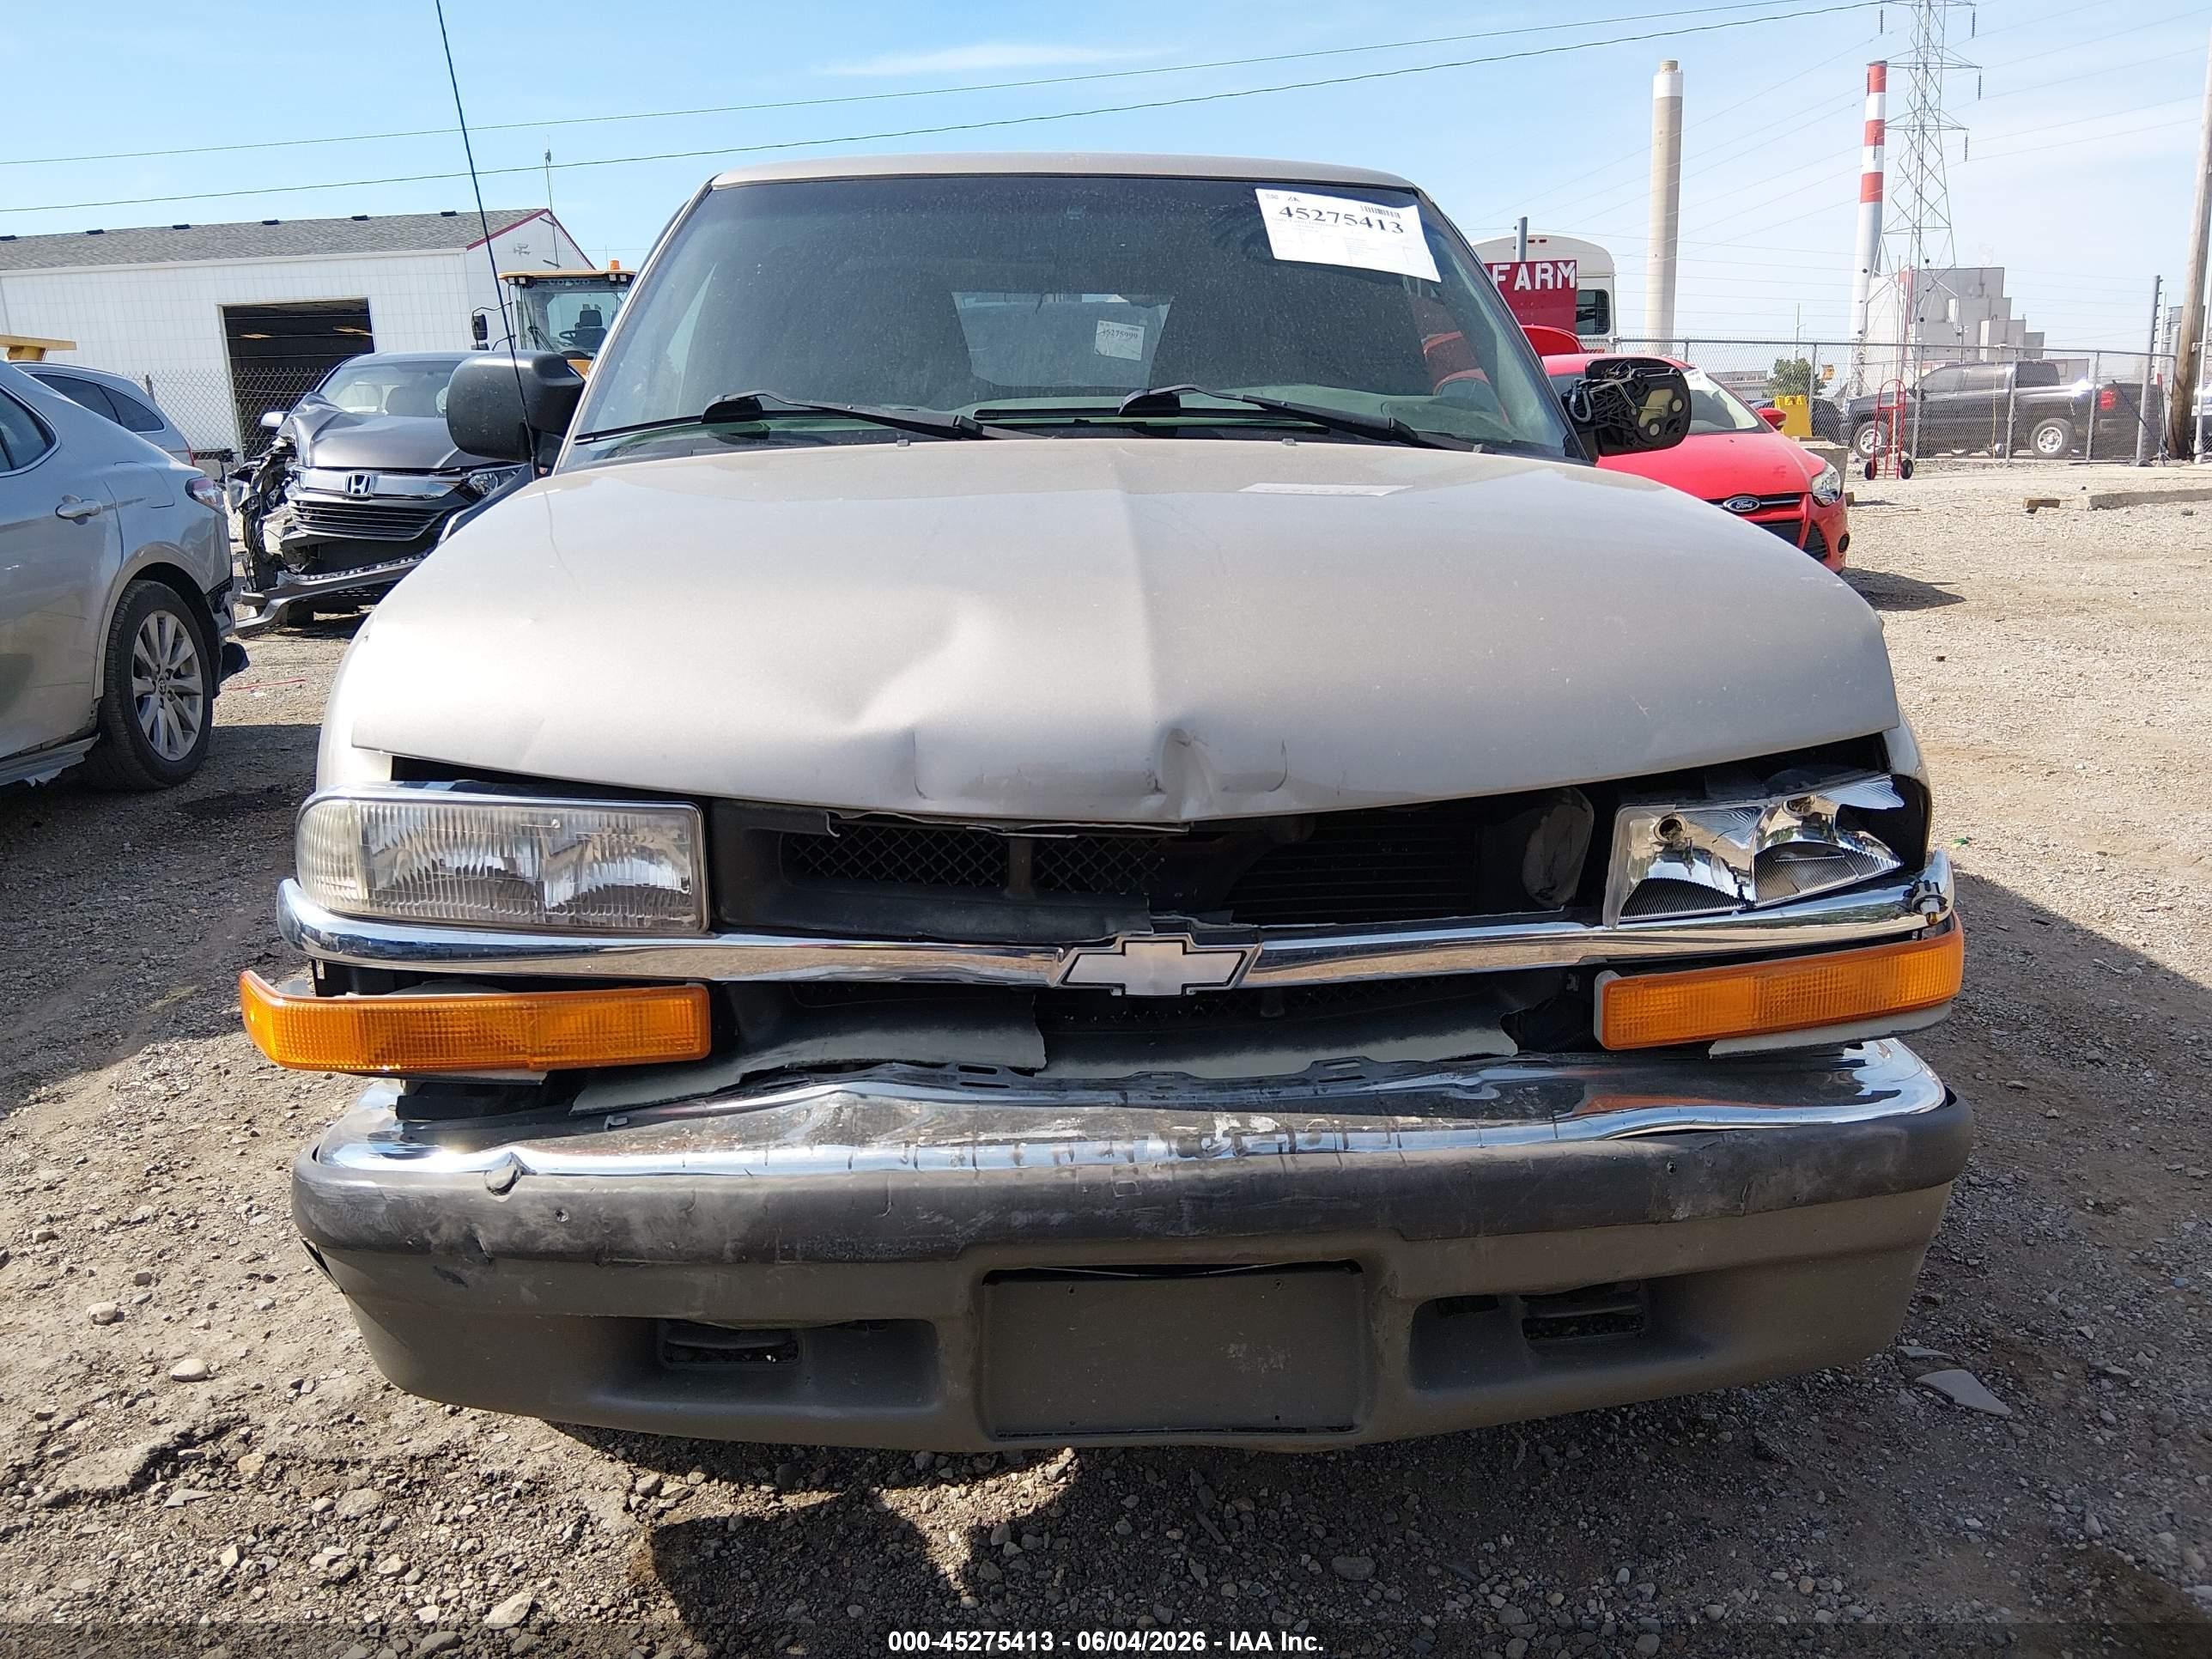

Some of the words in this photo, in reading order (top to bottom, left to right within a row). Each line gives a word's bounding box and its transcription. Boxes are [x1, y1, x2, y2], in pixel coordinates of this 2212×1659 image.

[1279, 205, 1405, 234] 45275413
[1492, 261, 1577, 291] FARM
[1735, 500, 1754, 509] Ford
